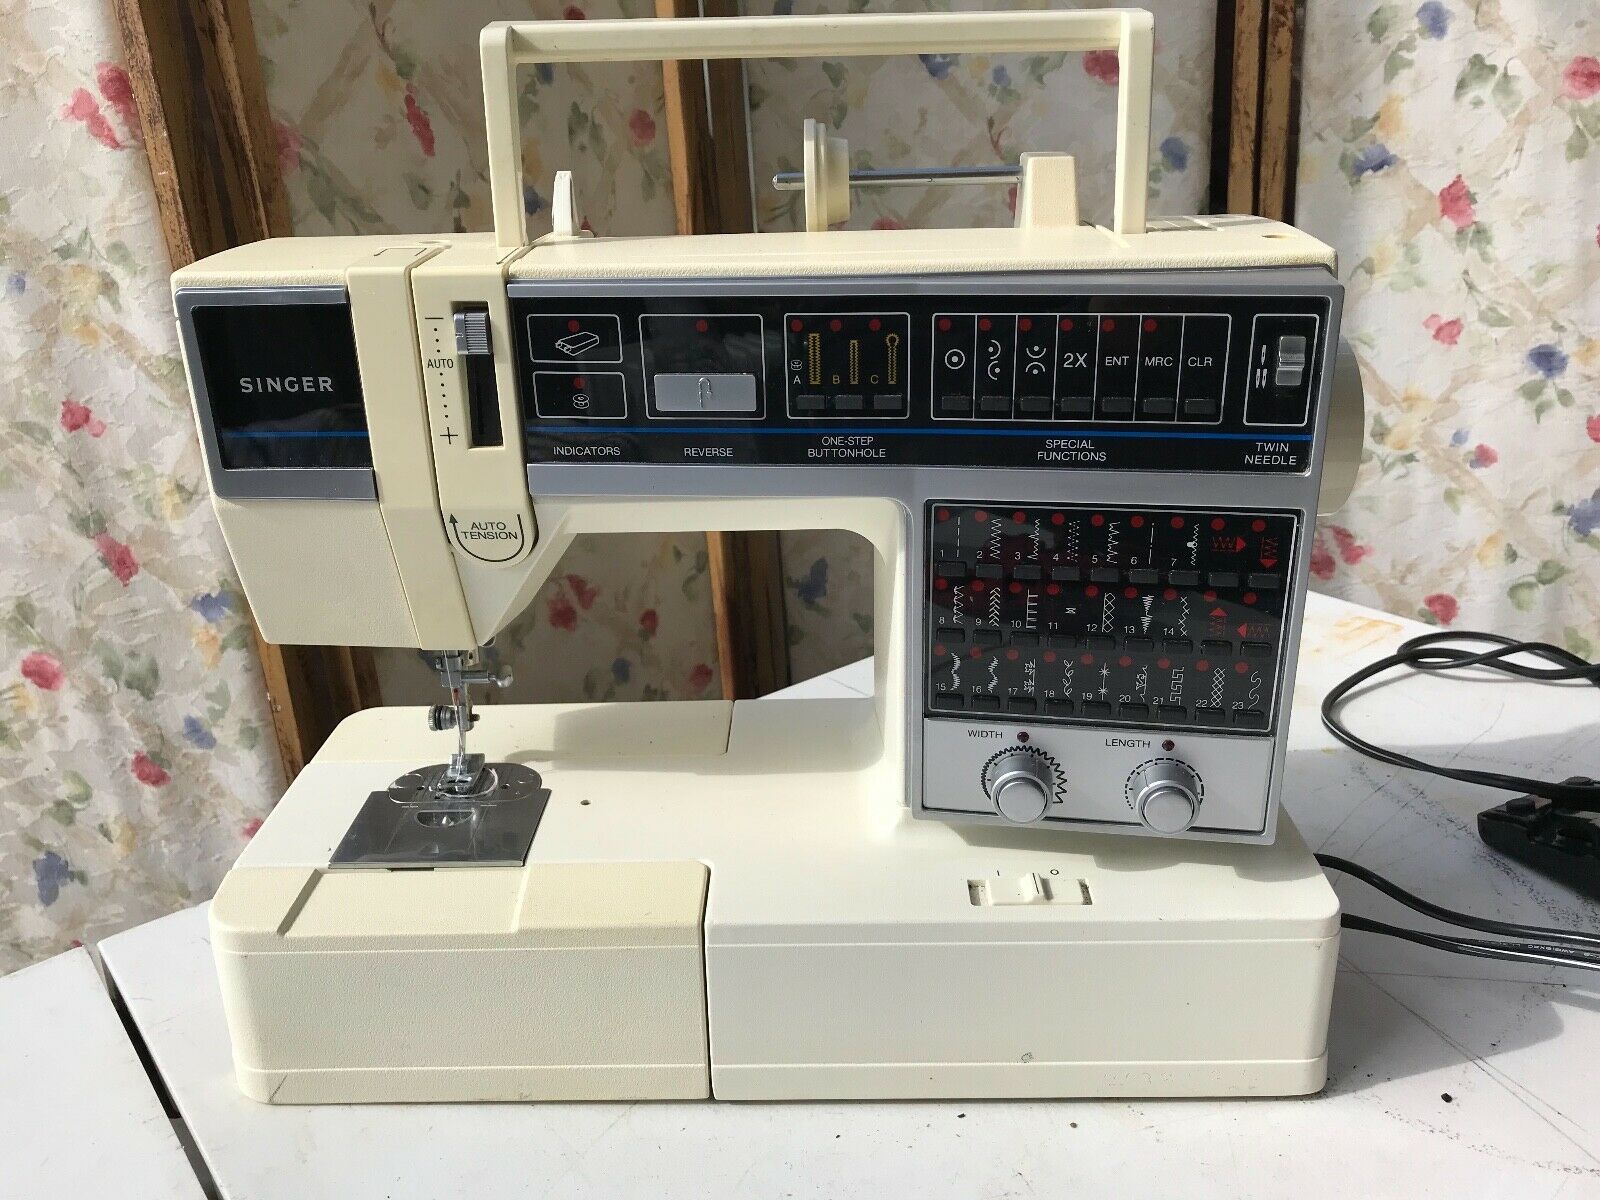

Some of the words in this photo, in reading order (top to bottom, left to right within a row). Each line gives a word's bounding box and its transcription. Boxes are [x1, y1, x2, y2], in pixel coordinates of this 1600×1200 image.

[427, 358, 454, 369] AUTO
[1063, 352, 1088, 368] 2X
[1105, 355, 1130, 366] ENT
[1144, 356, 1174, 367] MRC
[1187, 356, 1213, 367] CLR
[239, 376, 334, 393] SINGER
[793, 375, 801, 385] A
[832, 374, 841, 385] B
[870, 374, 879, 385] C
[821, 436, 874, 446] ONE-STEP
[1045, 439, 1095, 449] SPECIAL
[553, 446, 621, 456] INDICATORS
[683, 447, 734, 457] REVERSE
[1255, 442, 1289, 453] TWIN
[807, 448, 886, 458] BUTTONHOLE
[1037, 451, 1107, 462] FUNCTIONS
[1244, 454, 1297, 466] NEEDLE
[470, 521, 507, 531] AUTO
[461, 531, 518, 541] TENSION
[940, 549, 944, 558] 1
[976, 550, 983, 559] 2
[1014, 551, 1021, 561] 3
[1052, 553, 1060, 562] 4
[1091, 554, 1098, 564] 5
[1130, 556, 1138, 565] 6
[1171, 557, 1177, 567] 7
[938, 616, 945, 625] 8
[975, 617, 982, 626] 9
[1010, 619, 1022, 629] 10
[1048, 621, 1058, 630] 11
[1086, 623, 1098, 632] 12
[1124, 625, 1135, 634] 13
[1163, 627, 1174, 636] 14
[935, 682, 947, 691] 15
[972, 685, 982, 694] 16
[1007, 687, 1018, 696] 17
[1043, 689, 1055, 698] 18
[1082, 692, 1093, 701] 19
[1118, 694, 1132, 703] 20
[1152, 696, 1164, 705] 21
[1195, 699, 1208, 708] 22
[1231, 701, 1244, 710] 23
[967, 729, 1003, 739] WIDTH
[1105, 738, 1151, 749] LENGTH
